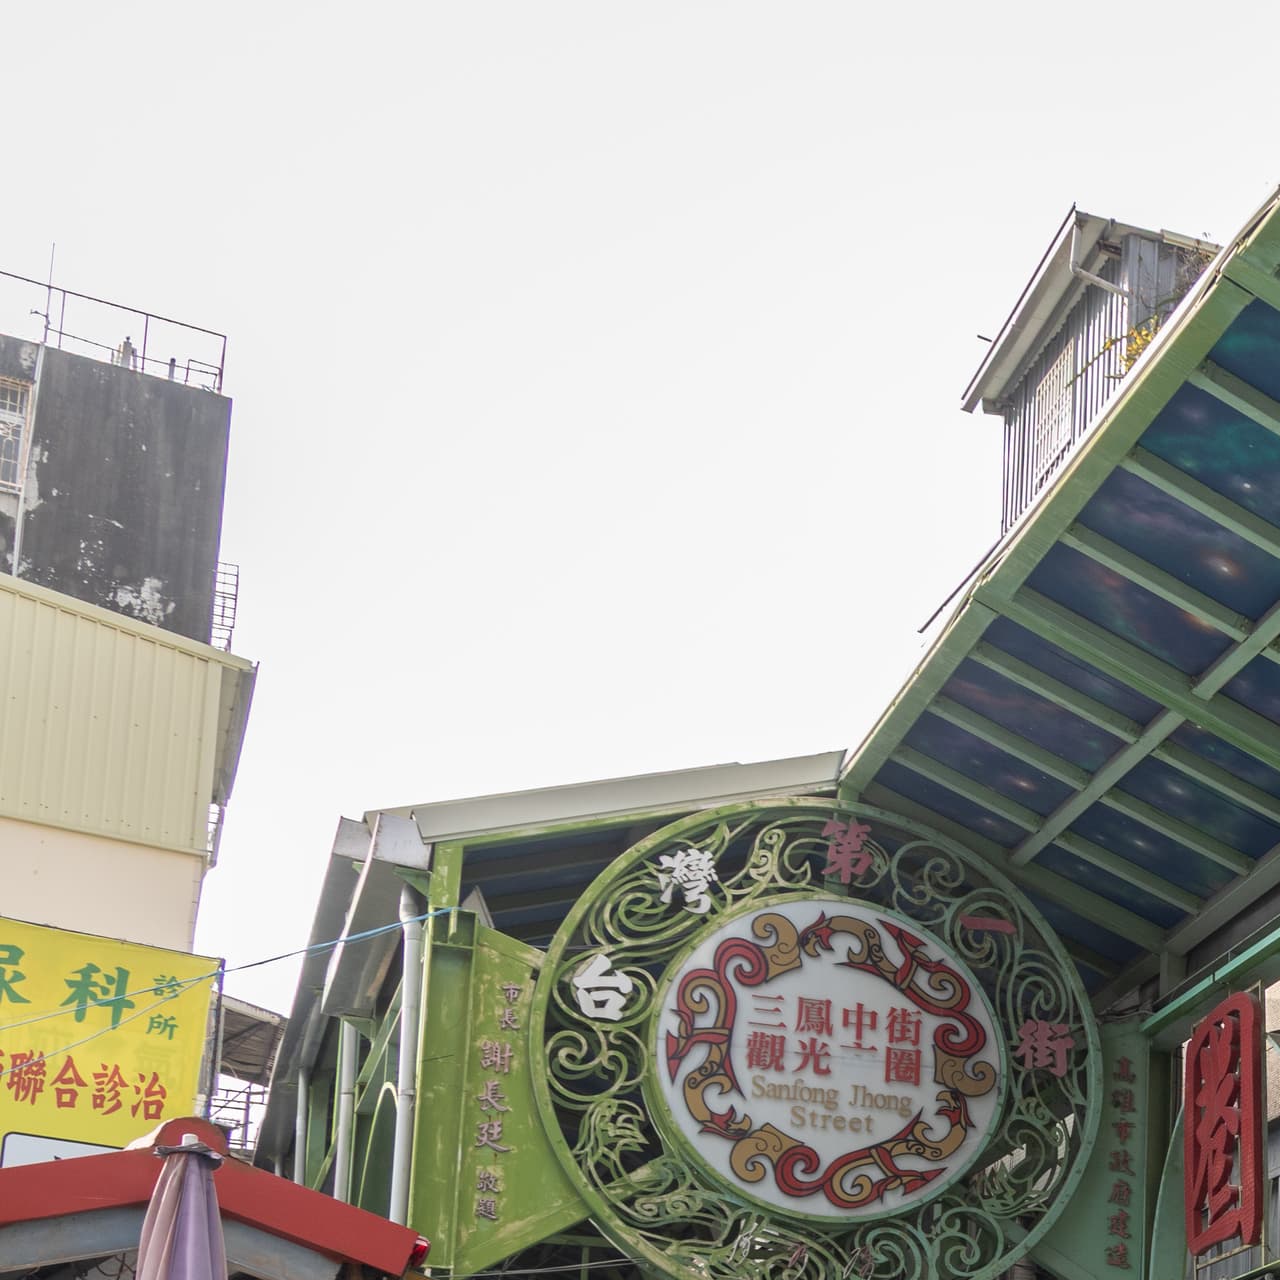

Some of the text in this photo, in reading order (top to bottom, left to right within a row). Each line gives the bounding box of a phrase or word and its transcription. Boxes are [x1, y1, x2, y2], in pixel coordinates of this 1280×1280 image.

[146, 974, 185, 1041] 診所
[497, 981, 521, 1031] 市長
[748, 992, 923, 1047] 三鳳中街
[0, 1049, 168, 1121] 聯合診治
[745, 1031, 922, 1087] 觀光圈
[475, 1040, 513, 1156] 謝長廷
[751, 1076, 913, 1118] Sanfong Jhong
[790, 1105, 874, 1135] Street
[1105, 1057, 1138, 1270] 高雄市政府建造
